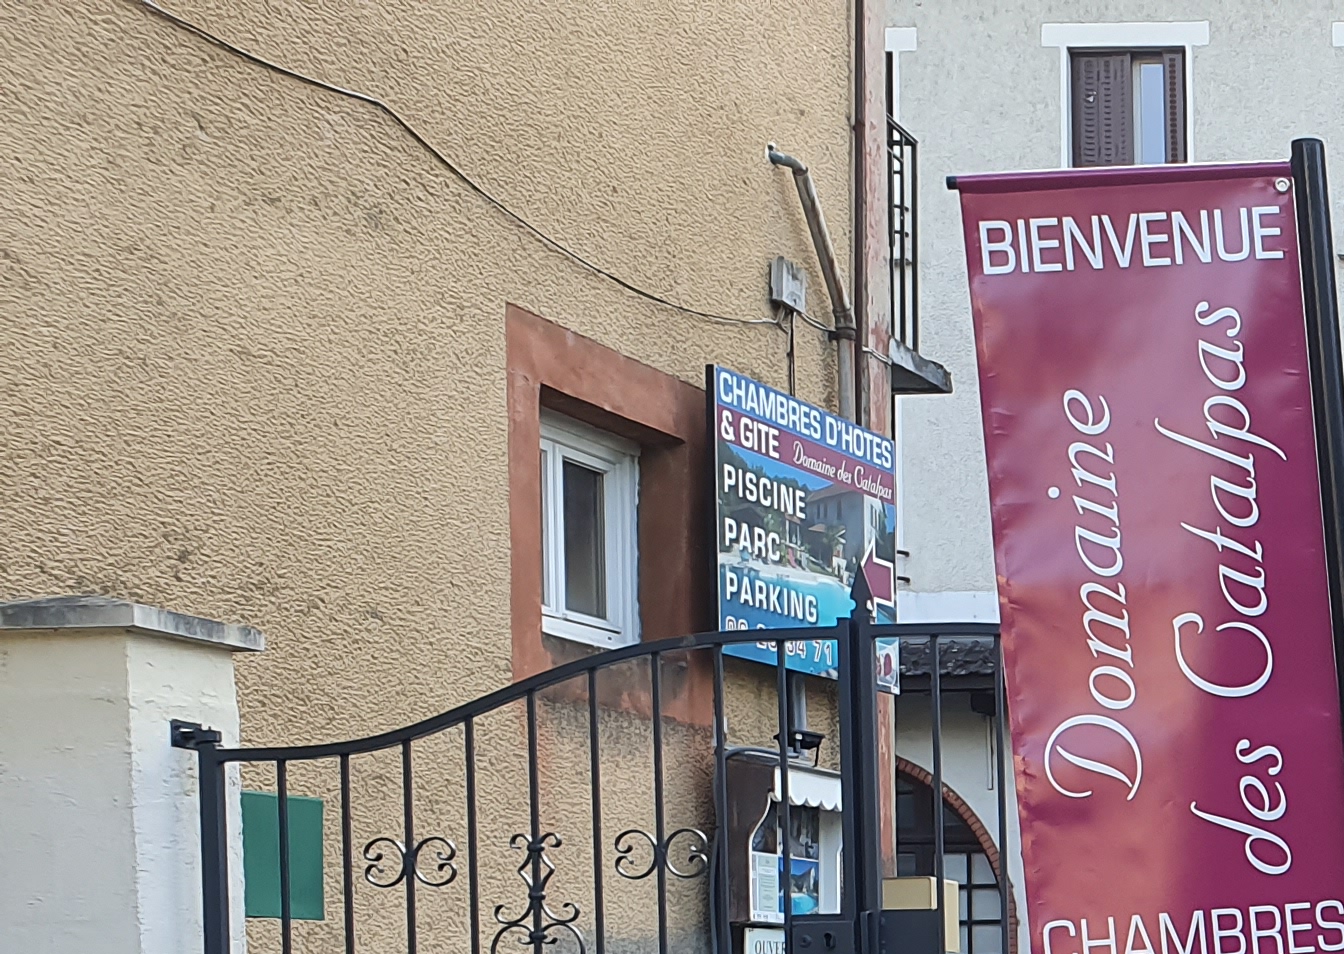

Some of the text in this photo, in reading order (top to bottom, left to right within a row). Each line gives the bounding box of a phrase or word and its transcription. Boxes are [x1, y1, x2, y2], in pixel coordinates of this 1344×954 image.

[979, 205, 1285, 275] BIENVENUE
[719, 371, 892, 469] CHAMBRES D'HOTES
[720, 409, 893, 500] & GITE Domaine des Catalpas
[723, 463, 806, 519] PISCINE
[724, 517, 780, 562] PARC
[725, 571, 818, 623] PARKING
[1043, 387, 1142, 801] Domaine
[1154, 300, 1292, 875] des Catalpas
[812, 640, 832, 666] 71
